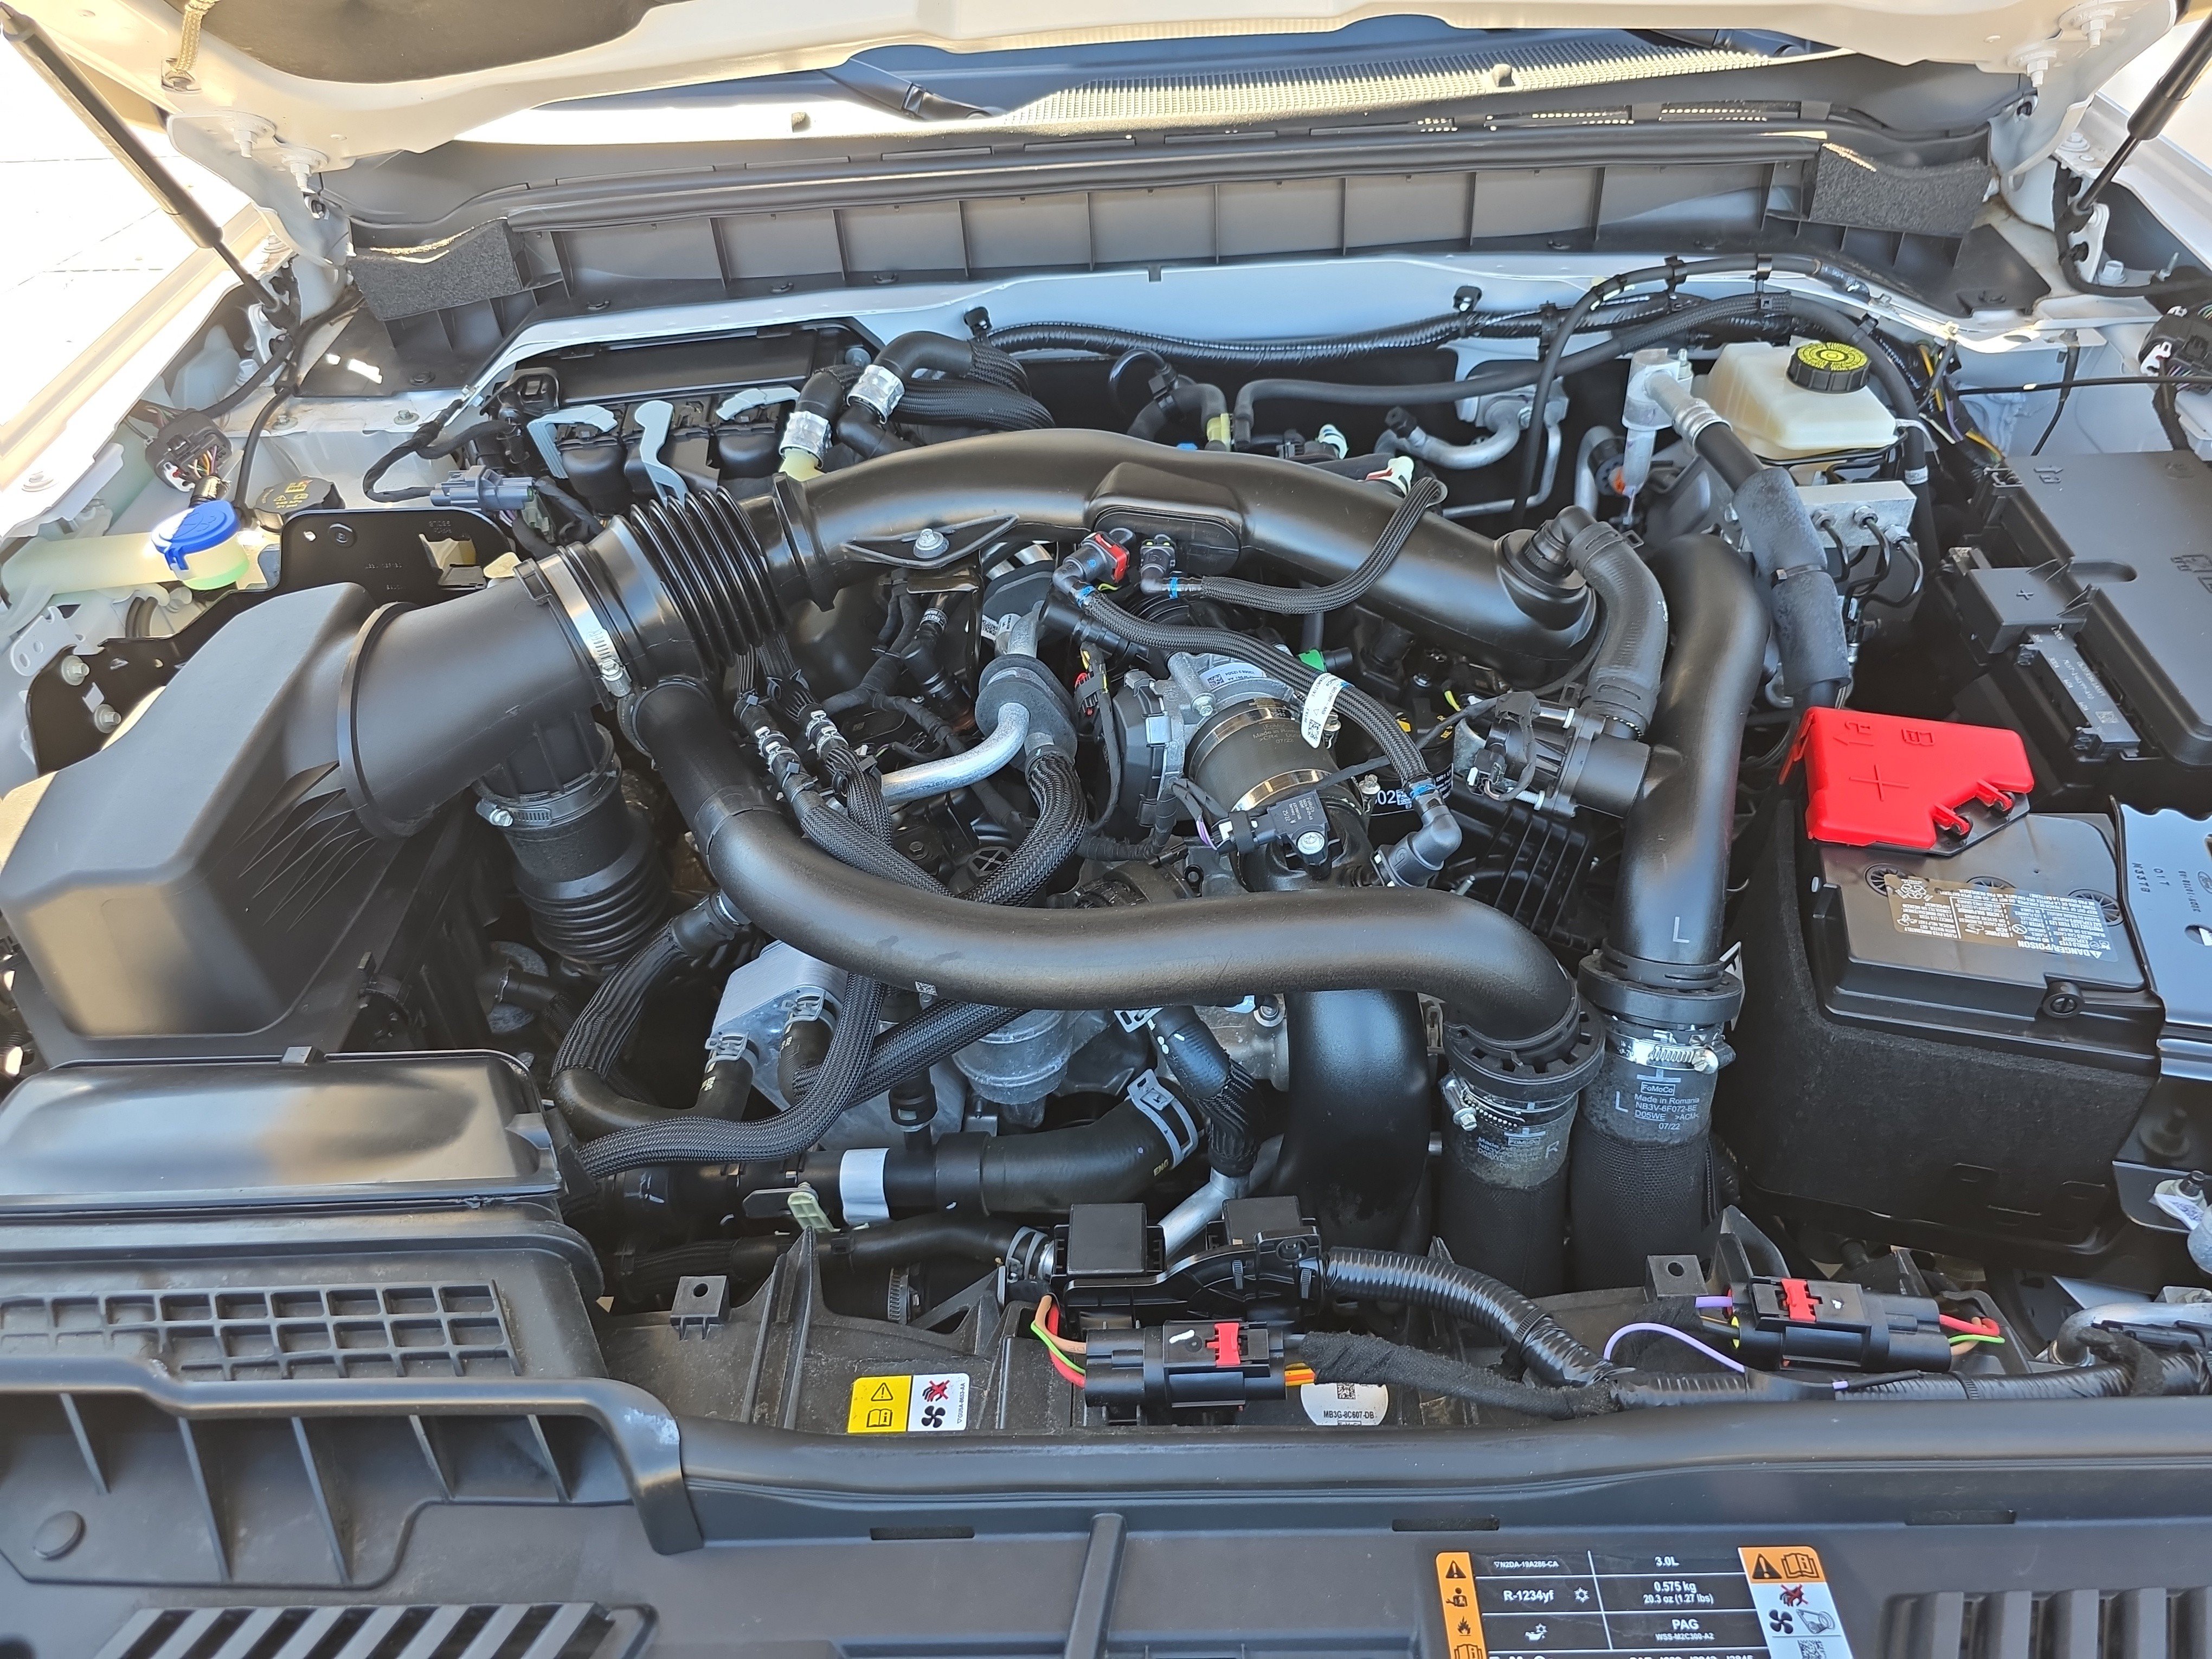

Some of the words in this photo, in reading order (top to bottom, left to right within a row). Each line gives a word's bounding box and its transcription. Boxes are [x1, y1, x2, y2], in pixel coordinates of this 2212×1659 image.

[1374, 790, 1397, 805] 02
[1673, 916, 1689, 943] L
[2018, 941, 2090, 956] DANGER/POISON
[1642, 1085, 1674, 1094] FoMoCo
[1615, 1091, 1629, 1113] L
[1634, 1093, 1657, 1102] Made
[1477, 1136, 1500, 1149] Made
[1323, 1410, 1374, 1419] MB3G-8C607-DB
[1655, 1556, 1680, 1567] 3.0L
[1654, 1581, 1681, 1592] 0.575
[1682, 1581, 1697, 1593] kg
[1503, 1589, 1554, 1604] R-1234yf
[1643, 1594, 1662, 1604] 20.3
[1663, 1595, 1674, 1603] oz
[1675, 1593, 1695, 1605] (1.27
[1696, 1593, 1714, 1605] lbs)
[1671, 1619, 1699, 1630] PAG
